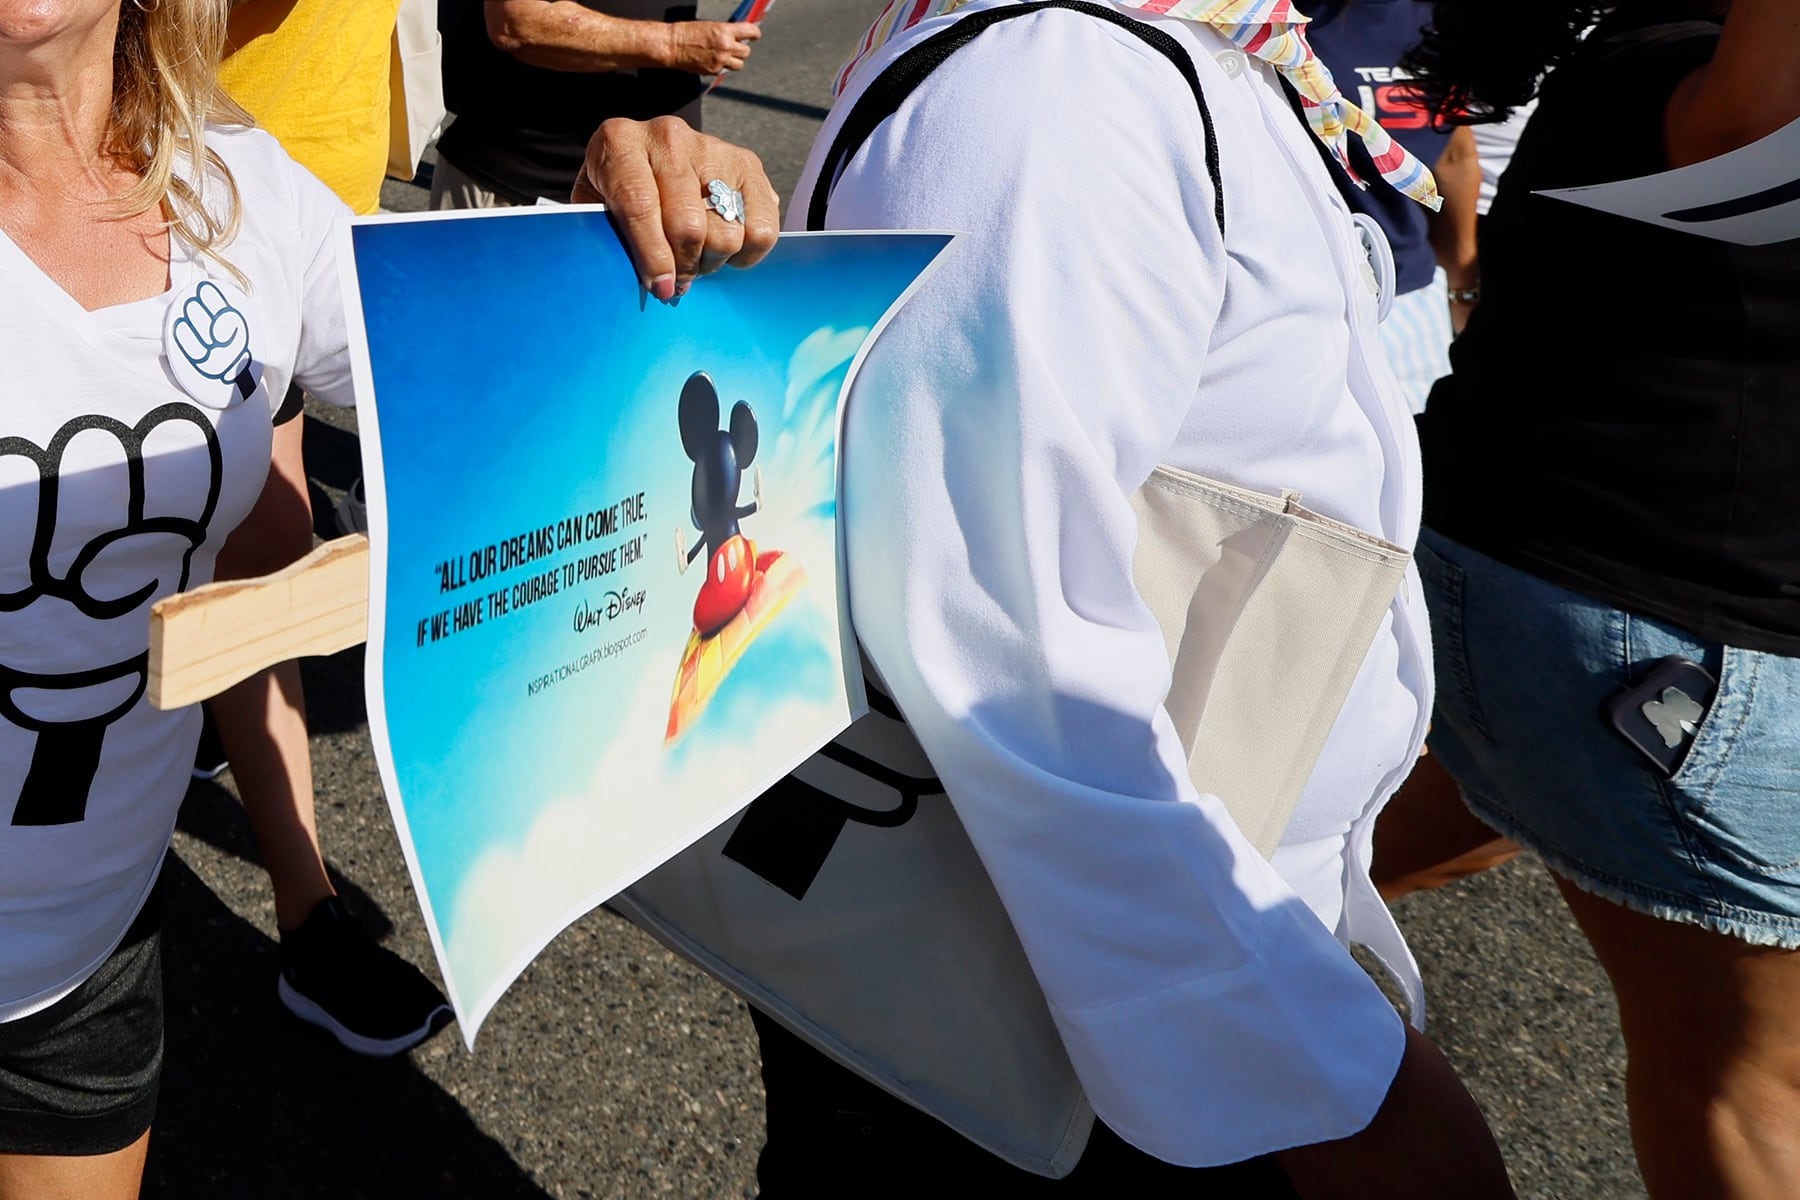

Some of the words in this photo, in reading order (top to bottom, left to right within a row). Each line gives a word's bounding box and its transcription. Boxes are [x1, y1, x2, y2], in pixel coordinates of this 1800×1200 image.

[469, 544, 497, 583] OUR
[500, 525, 554, 572] DREAMS
[557, 514, 582, 551] CAN
[585, 504, 618, 542] COME
[621, 492, 647, 529] TRUE,
[417, 618, 428, 648] IF
[431, 609, 450, 643] WE
[453, 596, 484, 634] HAVE
[487, 588, 509, 620] THE
[512, 568, 559, 611] COURAGE
[562, 561, 575, 590] TO
[577, 548, 617, 585] PURSUE
